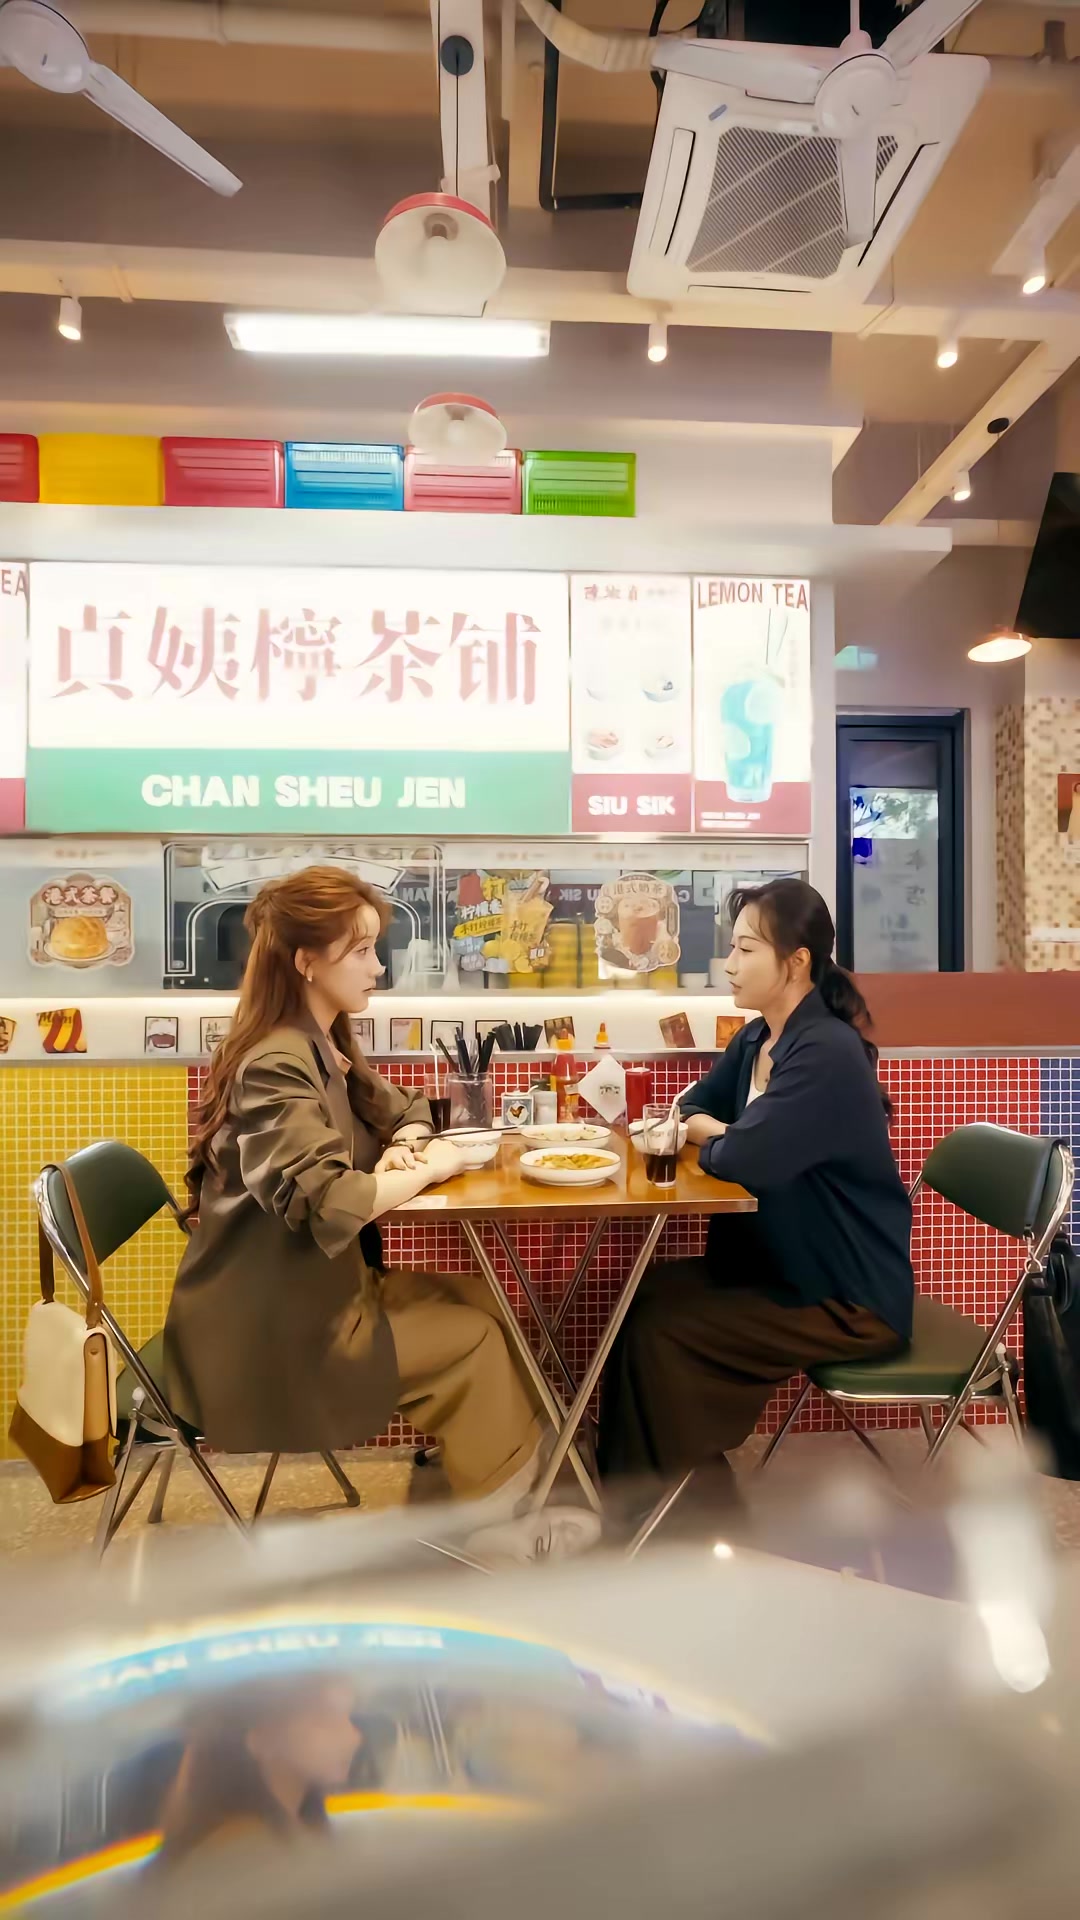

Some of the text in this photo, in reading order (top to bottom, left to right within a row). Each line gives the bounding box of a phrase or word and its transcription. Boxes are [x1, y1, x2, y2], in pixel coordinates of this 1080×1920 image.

[0, 569, 29, 602] EA
[697, 581, 809, 612] LEMON TEA
[141, 774, 466, 809] CHAN SHEU JEN
[588, 795, 676, 816] SIU SIK
